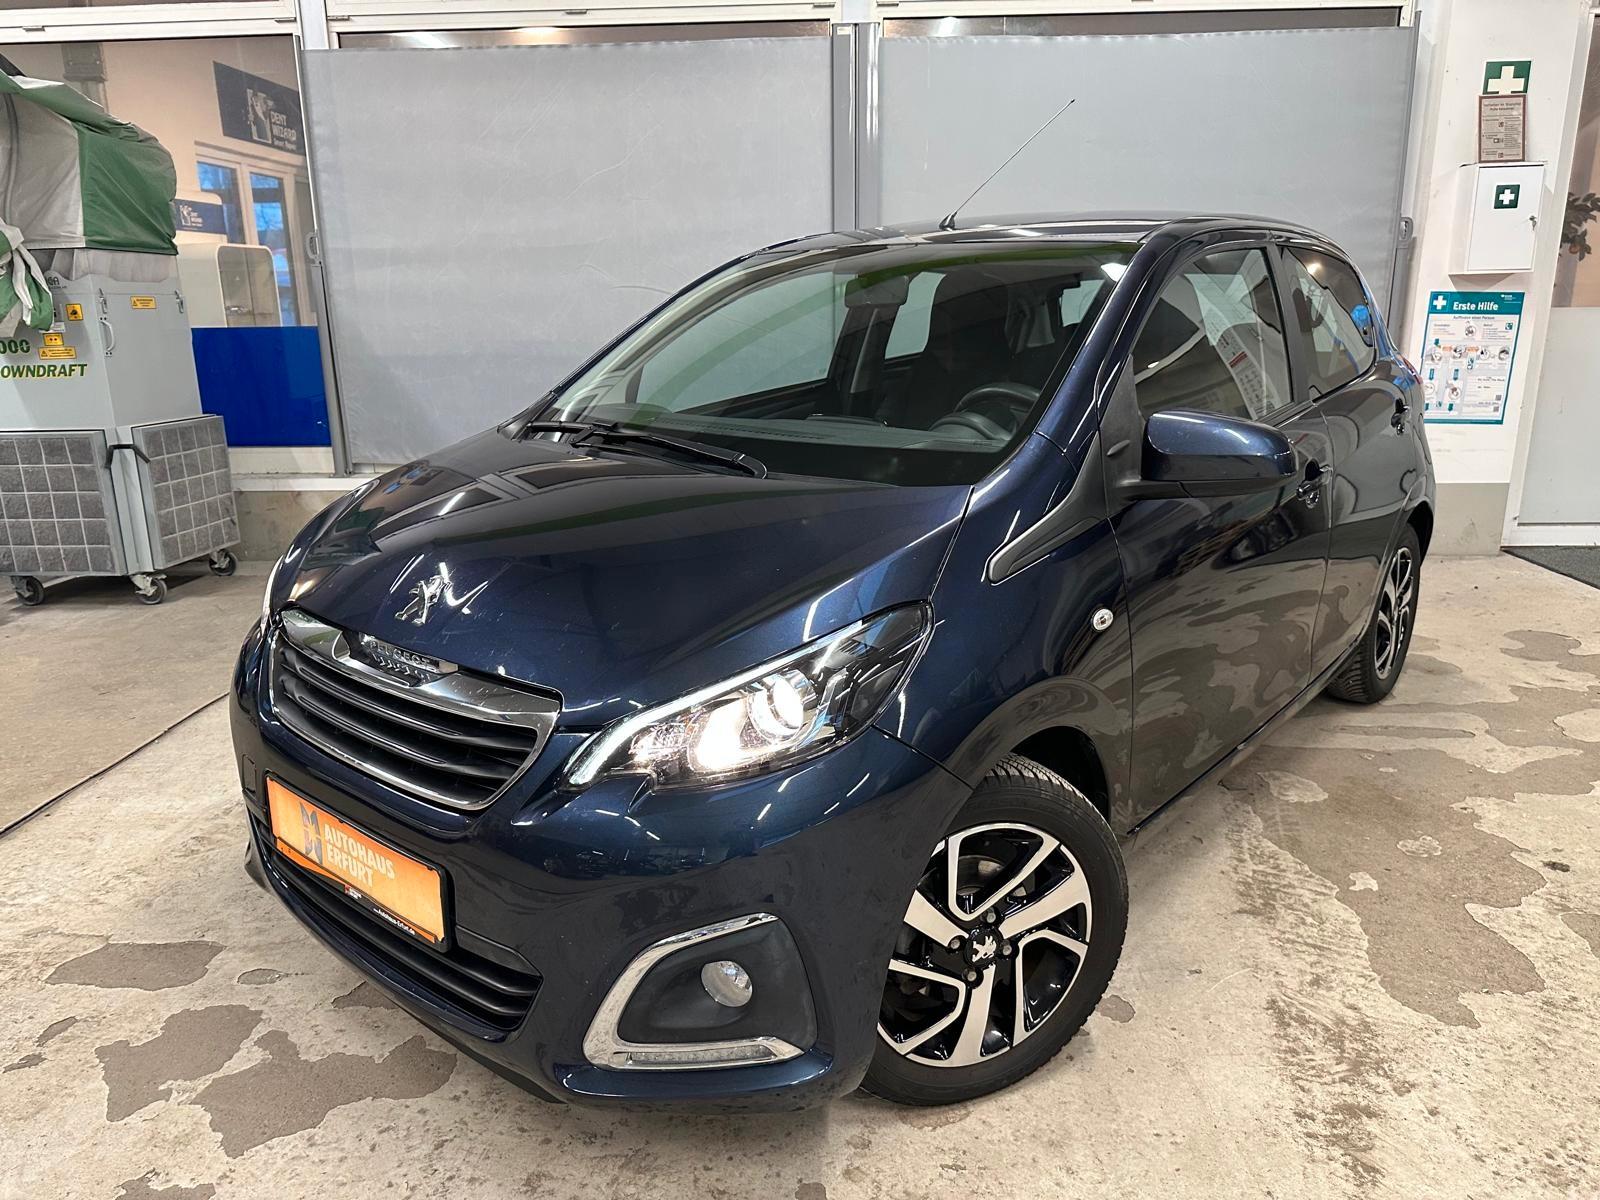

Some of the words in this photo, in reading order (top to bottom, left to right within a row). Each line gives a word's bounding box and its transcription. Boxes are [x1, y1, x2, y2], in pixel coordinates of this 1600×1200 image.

[271, 110, 287, 126] DENT
[271, 123, 297, 142] WIZARD
[1453, 301, 1476, 311] Erste
[1477, 301, 1499, 311] Hilfe
[324, 823, 396, 880] AUTOHAUS
[327, 842, 375, 888] ERFURT
